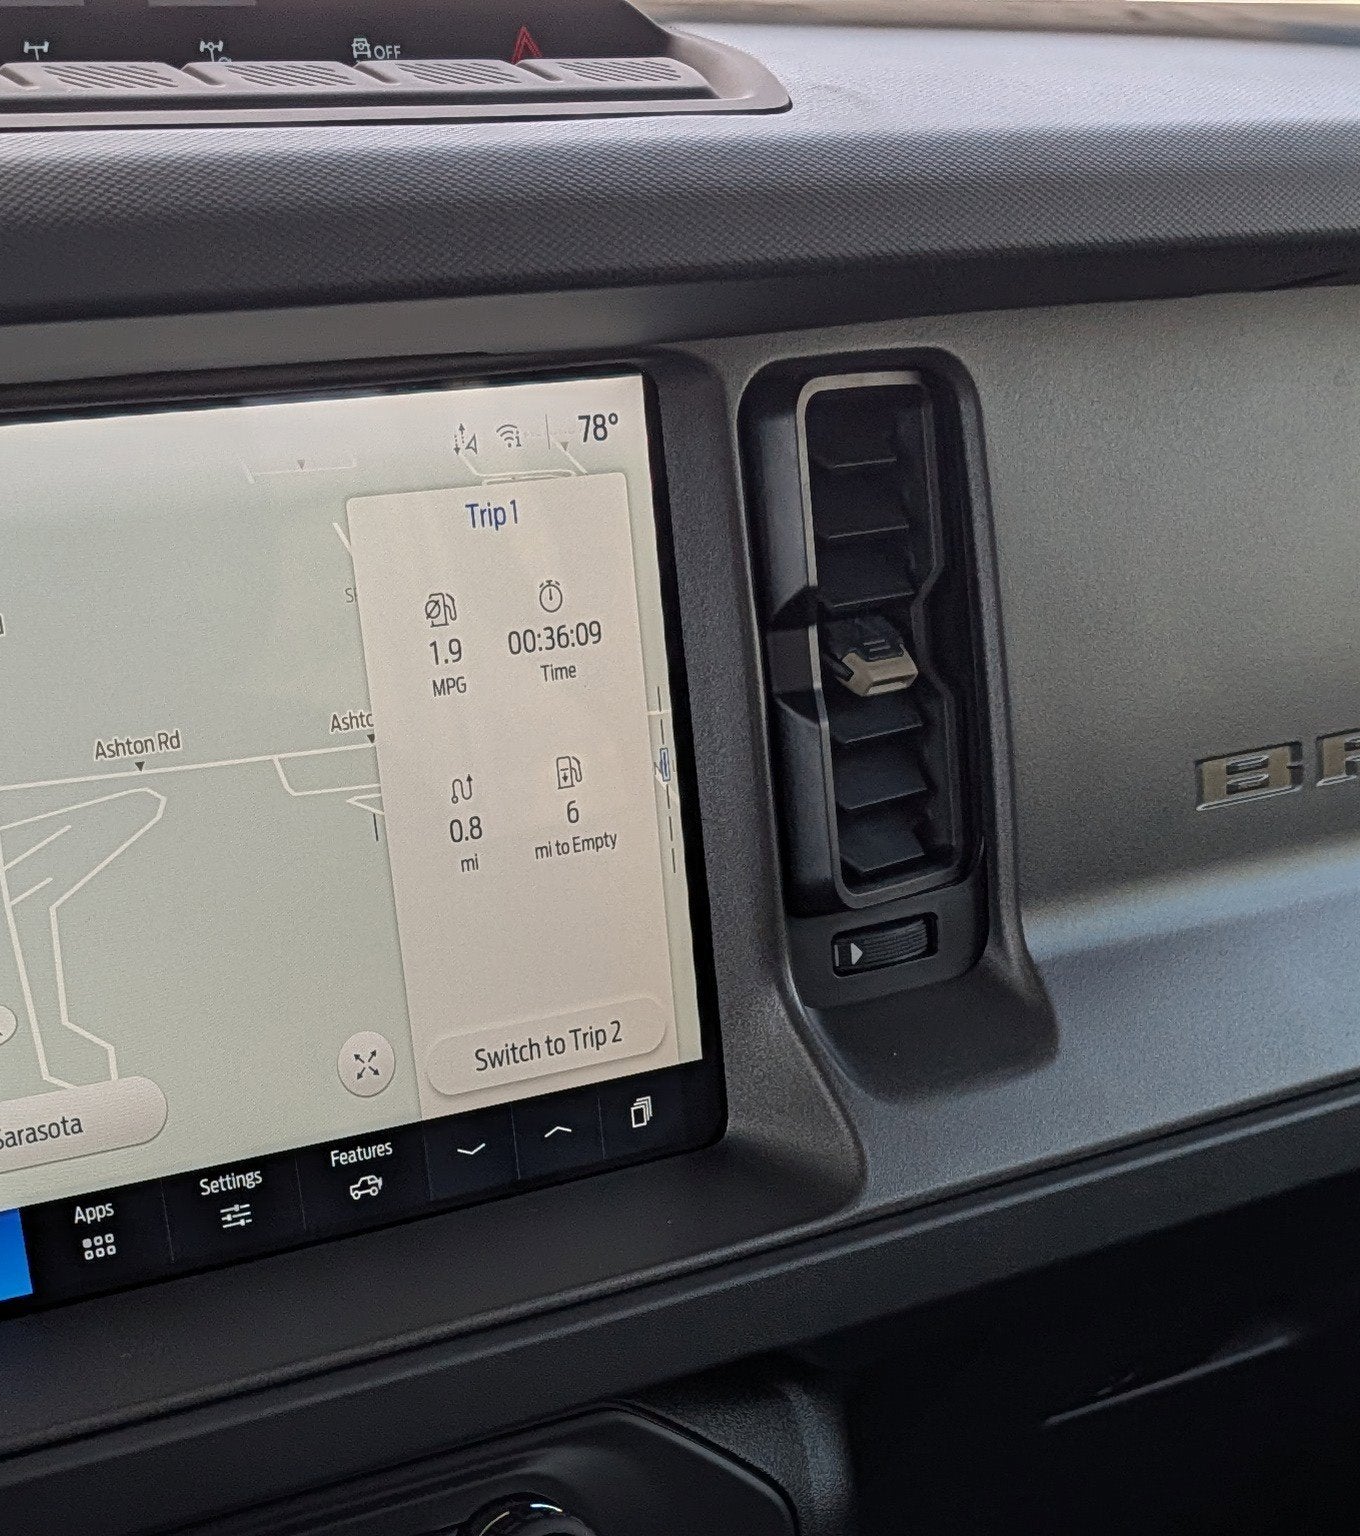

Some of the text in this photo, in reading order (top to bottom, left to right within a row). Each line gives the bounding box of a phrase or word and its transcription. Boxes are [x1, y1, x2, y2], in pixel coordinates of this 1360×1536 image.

[374, 45, 401, 60] OFF
[465, 500, 519, 530] Trip 1
[429, 638, 462, 667] 1.9
[507, 621, 602, 656] 00:36:09
[540, 661, 577, 683] Time
[431, 676, 468, 698] MPG
[94, 731, 182, 761] Ashton Rd
[566, 801, 579, 824] 6
[448, 815, 484, 845] 0.8
[534, 832, 617, 860] mi to Empty
[460, 853, 479, 874] mi
[474, 1020, 623, 1072] Switch to Trip 2
[330, 1140, 393, 1167] Features
[199, 1167, 264, 1197] Settings
[73, 1201, 115, 1227] Apps
